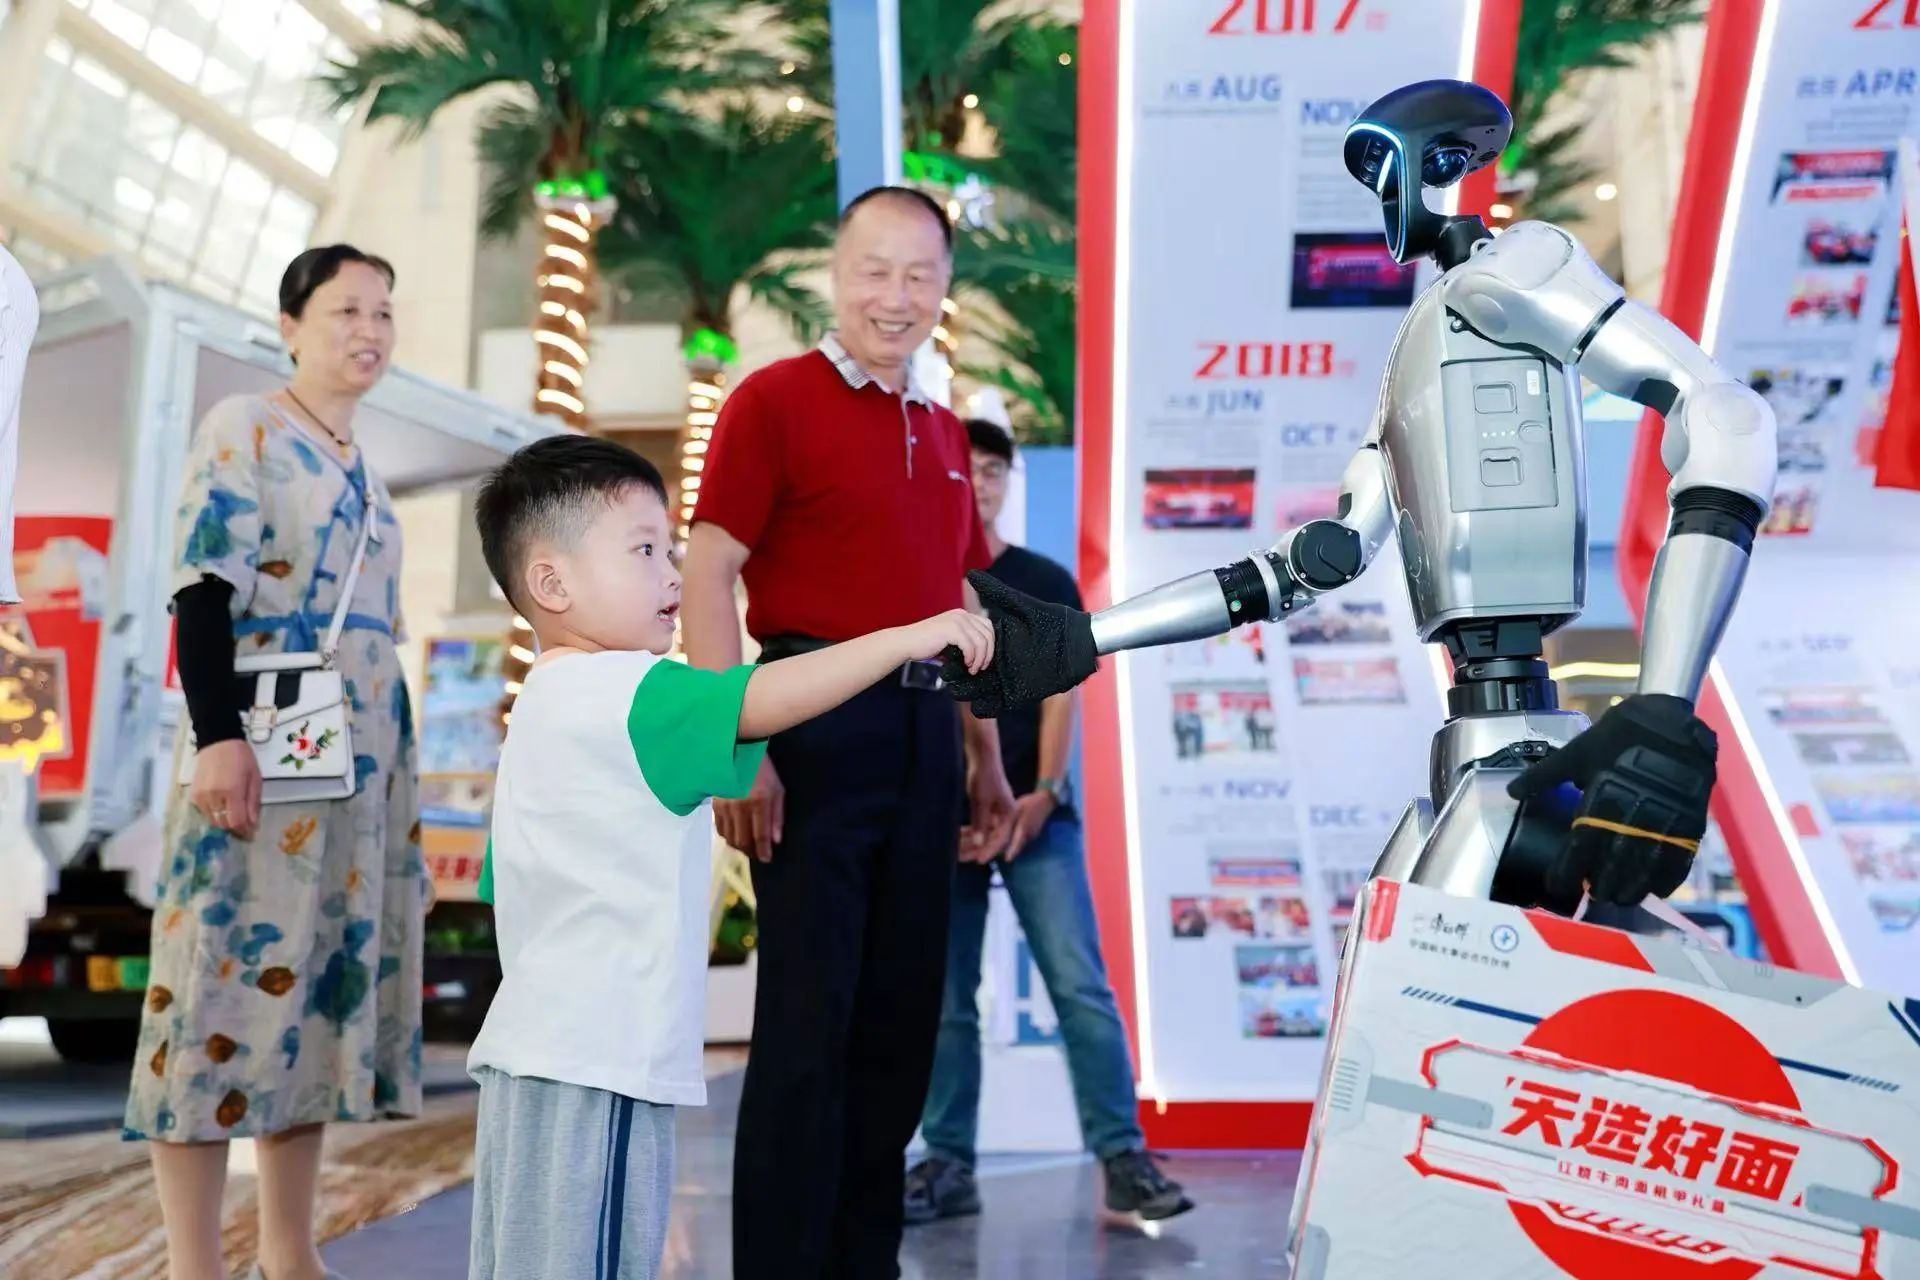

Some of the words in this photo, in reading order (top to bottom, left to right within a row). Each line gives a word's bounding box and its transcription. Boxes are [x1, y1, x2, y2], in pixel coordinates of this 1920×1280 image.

[1211, 73, 1281, 101] AUG
[1841, 67, 1915, 98] APR
[1194, 342, 1334, 379] 2018
[1206, 389, 1264, 415] JUN
[1280, 422, 1338, 447] OCT
[1223, 778, 1292, 799] NOV
[1500, 1079, 1801, 1202] 天选好面
